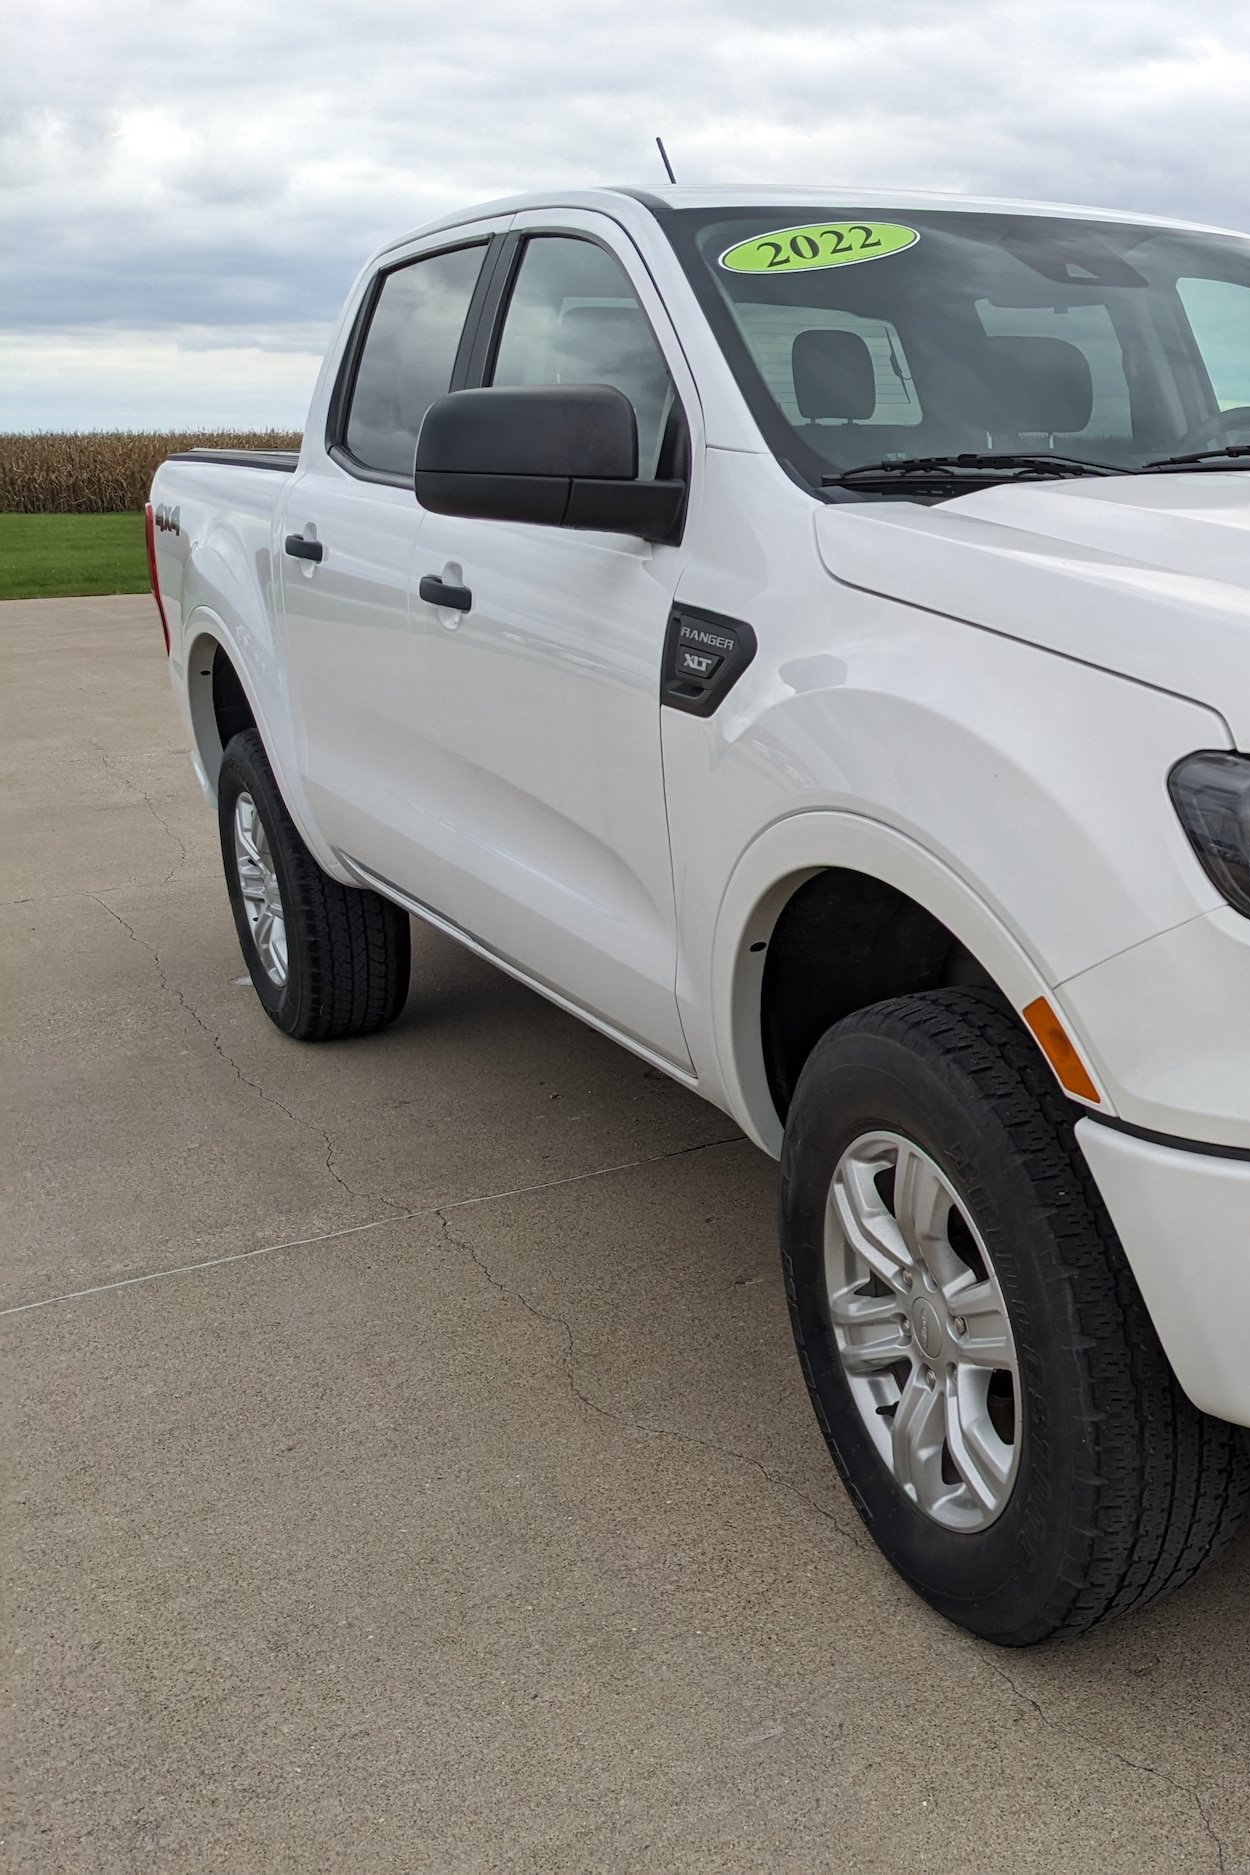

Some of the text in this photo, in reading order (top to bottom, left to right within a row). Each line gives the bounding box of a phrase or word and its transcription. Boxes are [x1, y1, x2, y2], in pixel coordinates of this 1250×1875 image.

[757, 225, 882, 268] 2022
[681, 627, 734, 650] RANGER
[683, 653, 712, 672] XLT
